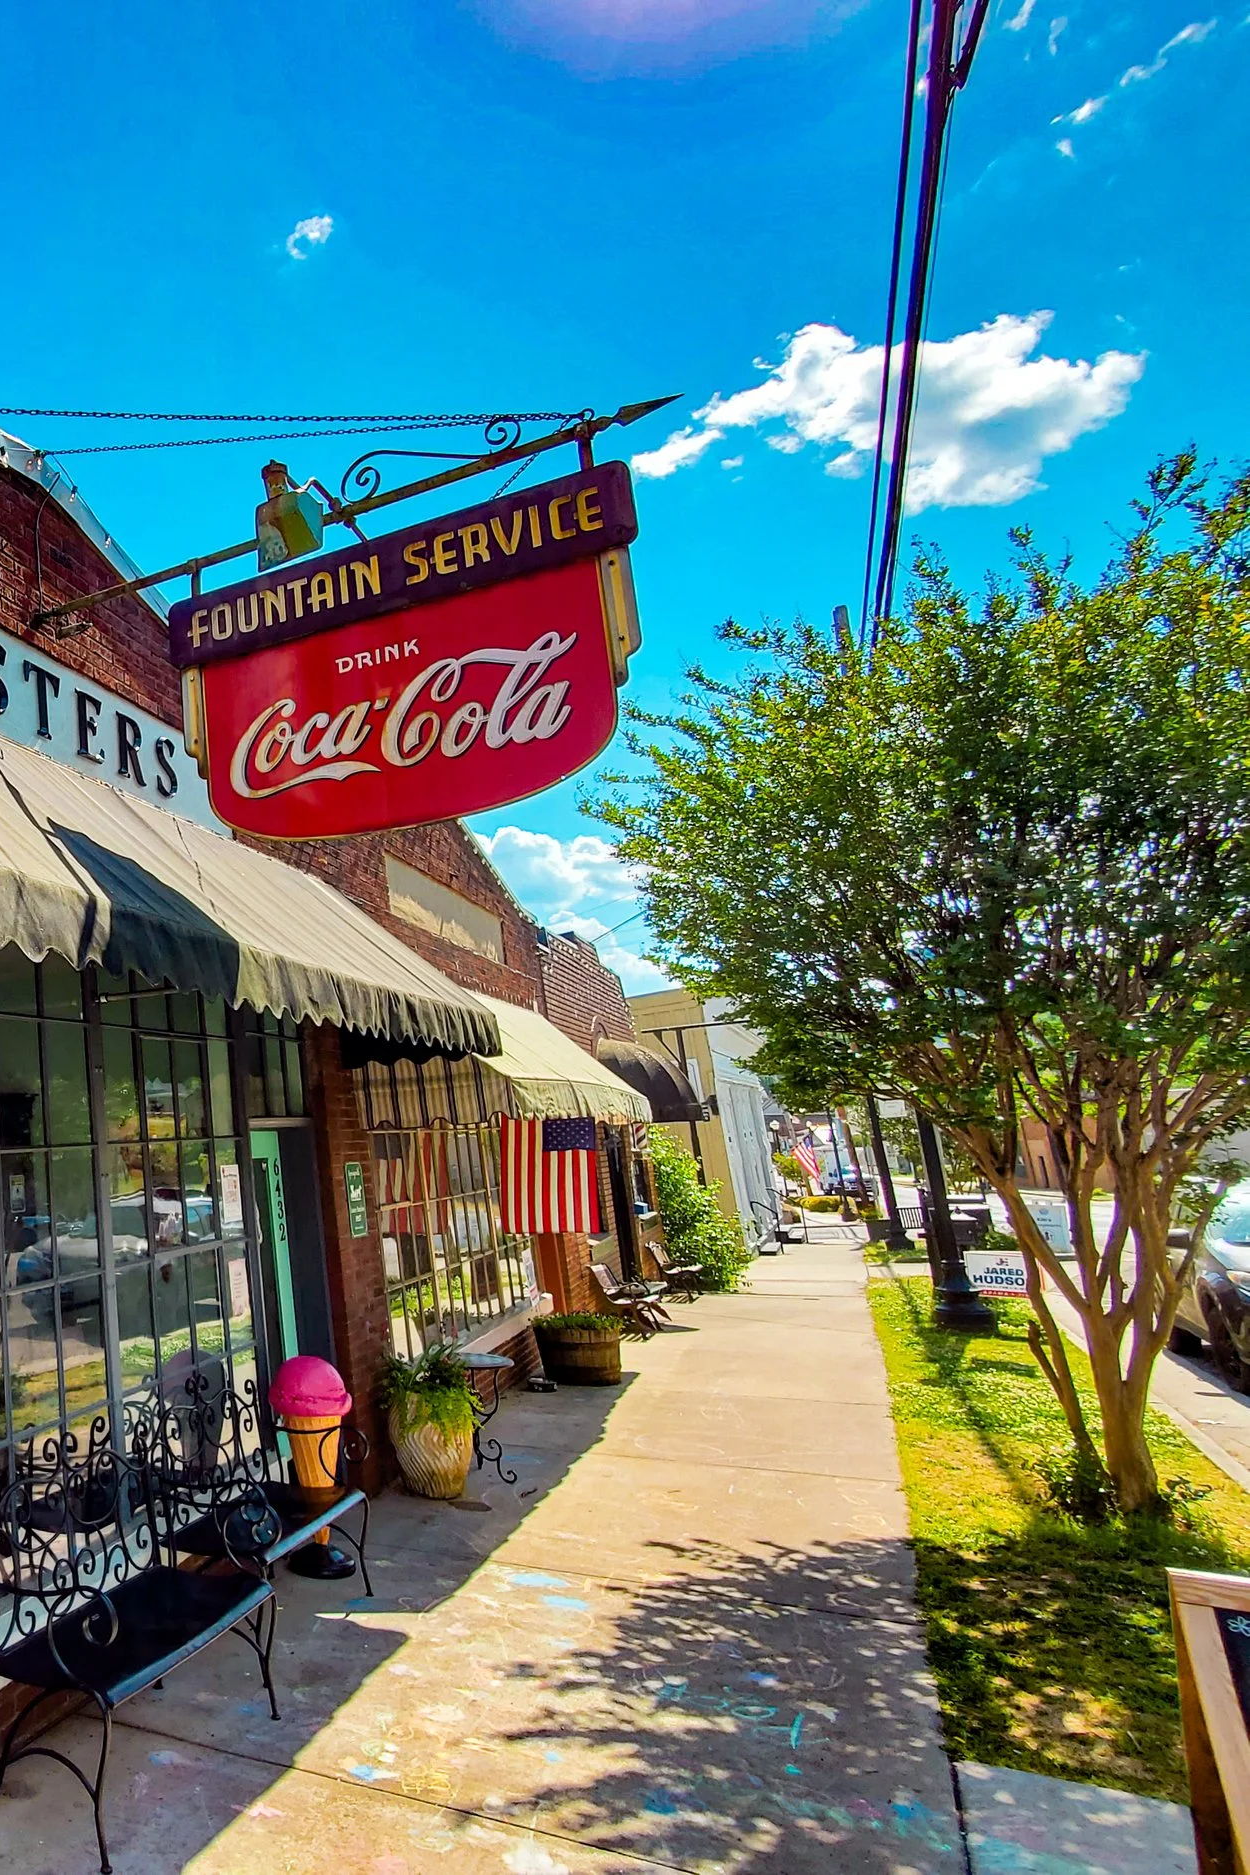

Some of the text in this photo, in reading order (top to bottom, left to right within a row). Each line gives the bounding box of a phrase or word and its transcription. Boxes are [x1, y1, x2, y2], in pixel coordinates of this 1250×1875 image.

[187, 486, 604, 648] FOUNTAIN SERVICE
[335, 638, 421, 675] DRINK
[273, 1157, 286, 1242] 6432
[973, 1275, 1025, 1287] HUDSO
[983, 1267, 1024, 1277] JARED
